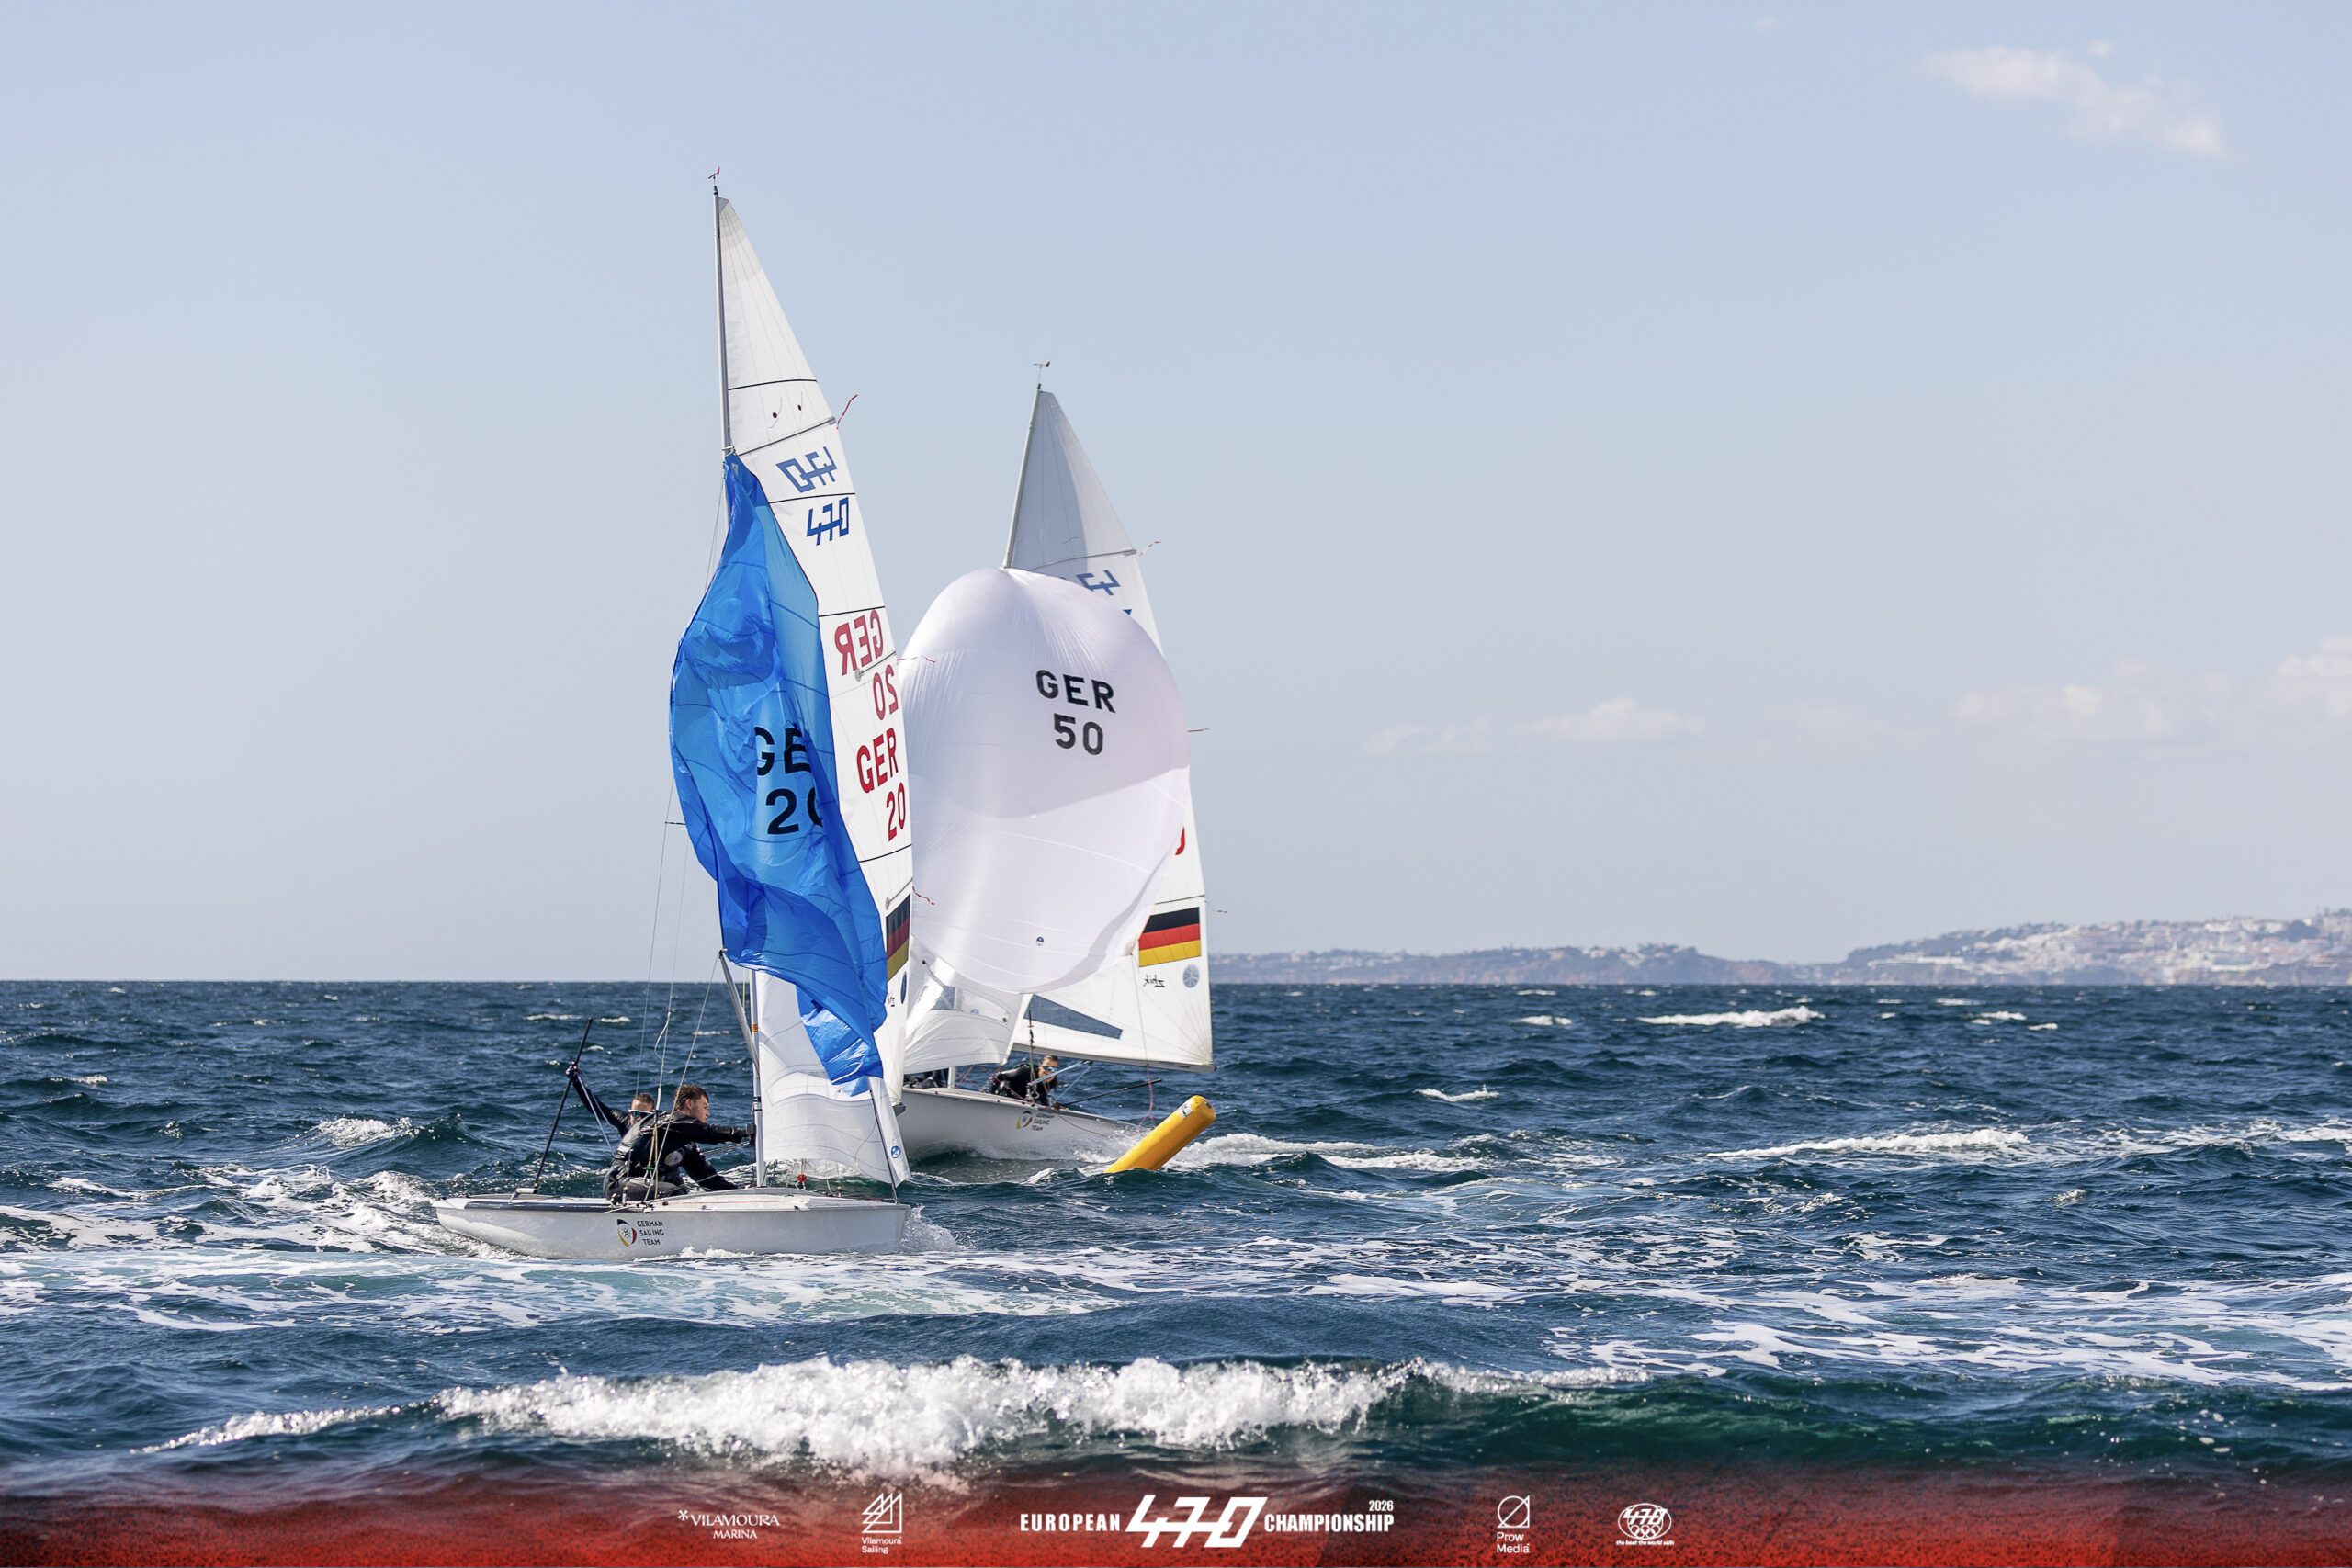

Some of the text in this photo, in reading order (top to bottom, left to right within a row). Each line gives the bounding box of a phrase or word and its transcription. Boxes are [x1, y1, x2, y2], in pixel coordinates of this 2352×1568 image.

[806, 497, 850, 546] 470
[1035, 669, 1116, 714] GER
[753, 726, 812, 776] GE
[1053, 713, 1104, 756] 50
[856, 728, 899, 794] GER
[886, 782, 906, 842] 20
